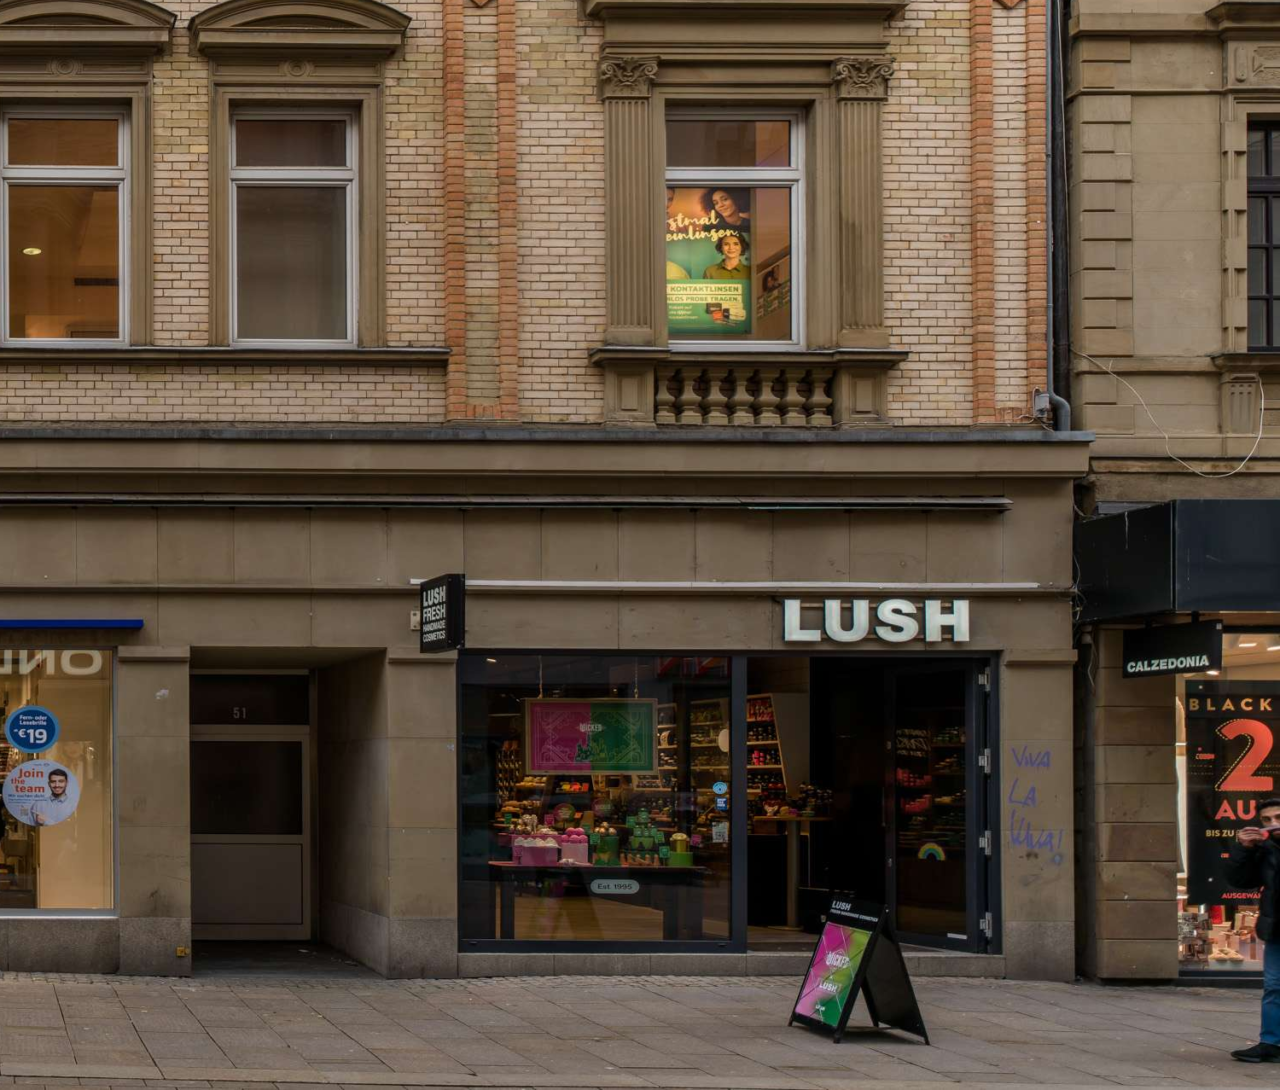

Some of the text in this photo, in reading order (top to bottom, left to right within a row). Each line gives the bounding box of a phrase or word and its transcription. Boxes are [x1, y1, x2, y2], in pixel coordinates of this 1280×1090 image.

[423, 586, 446, 607] LUSH
[423, 604, 446, 624] FRESH
[784, 599, 970, 642] LUSH
[423, 620, 446, 633] HANDMADE
[423, 630, 446, 643] COSMETICS
[1127, 655, 1209, 673] CALZEDONIA
[1189, 698, 1272, 711] BLACK
[233, 707, 246, 719] 51
[1216, 718, 1274, 791] 2
[19, 768, 44, 778] Join
[1009, 777, 1036, 807] LA
[1214, 800, 1257, 820] AU
[832, 900, 852, 910] LUSH
[820, 982, 838, 992] LUSH
